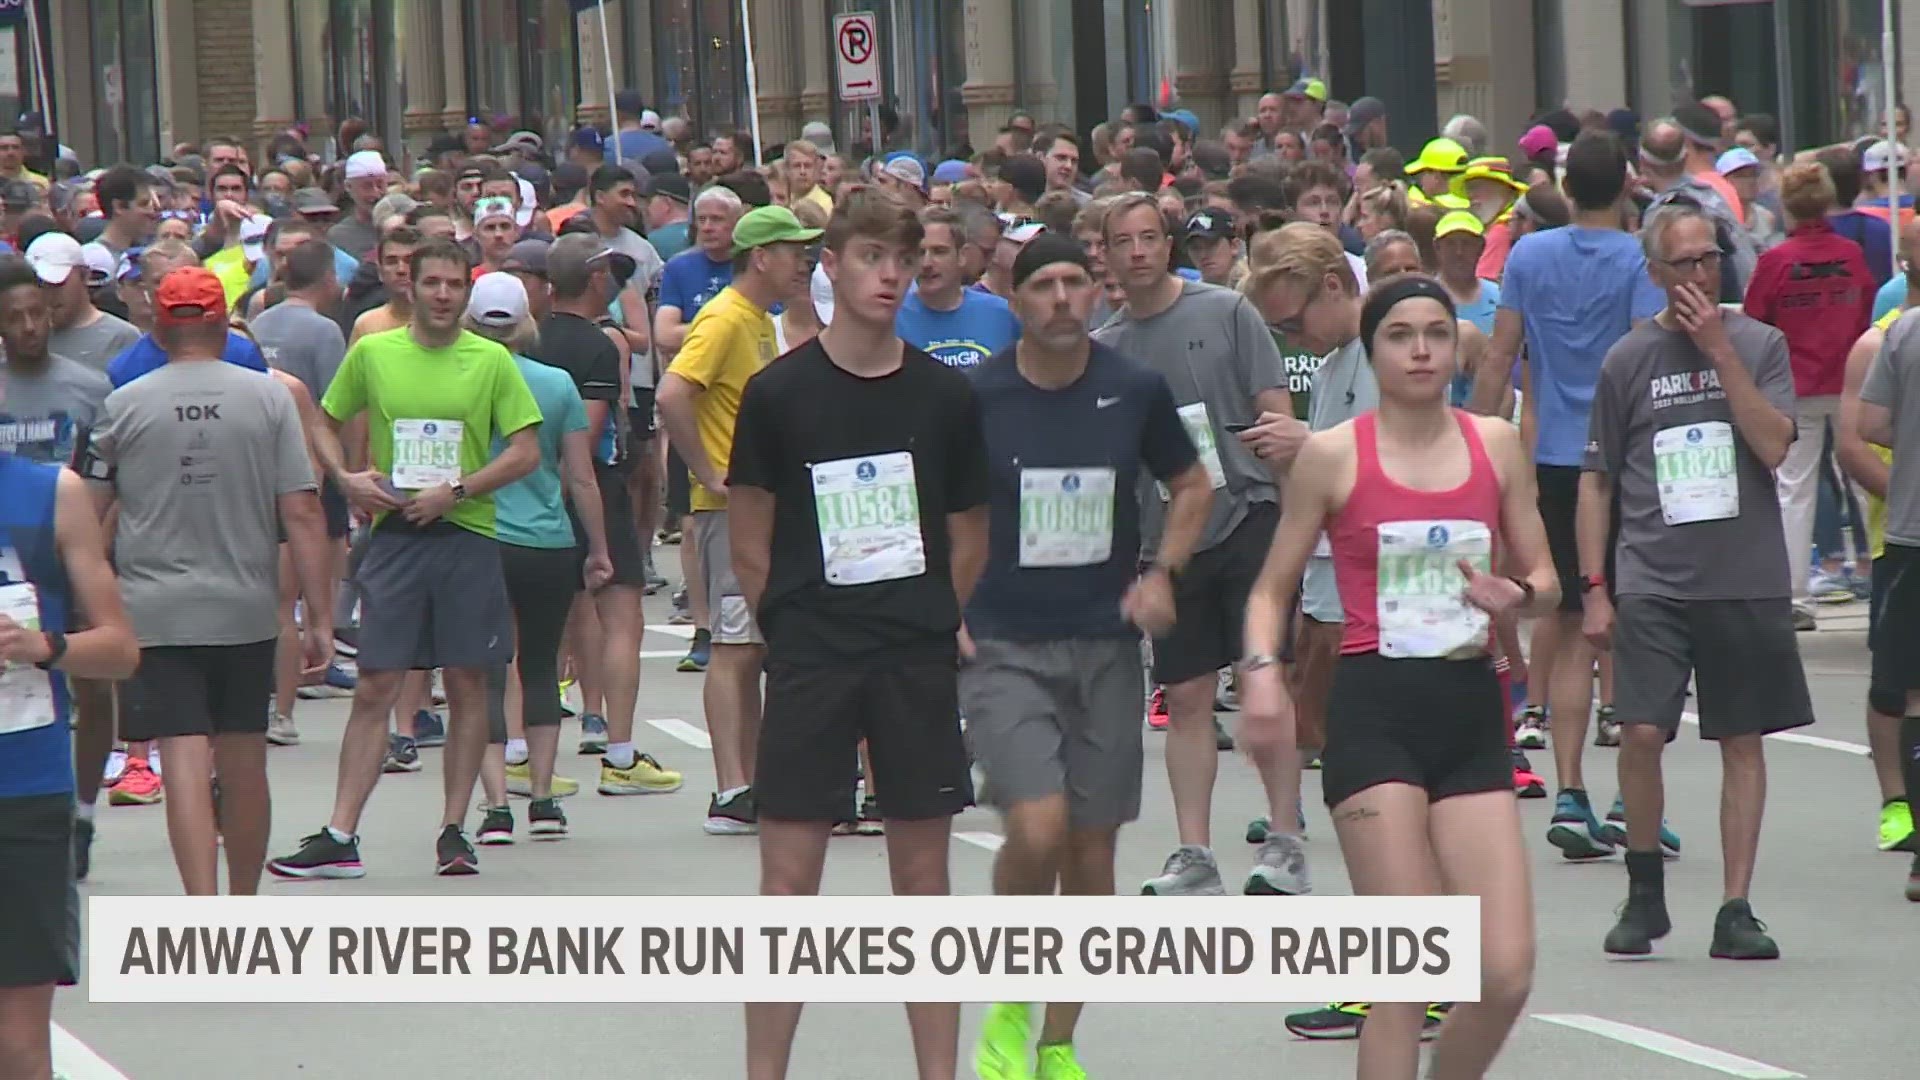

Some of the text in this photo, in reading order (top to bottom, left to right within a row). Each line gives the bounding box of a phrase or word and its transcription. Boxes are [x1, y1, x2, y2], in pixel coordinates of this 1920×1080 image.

[174, 404, 221, 422] 10K
[397, 440, 458, 465] 10933
[1660, 446, 1732, 482] 11820
[823, 484, 913, 529] 10584
